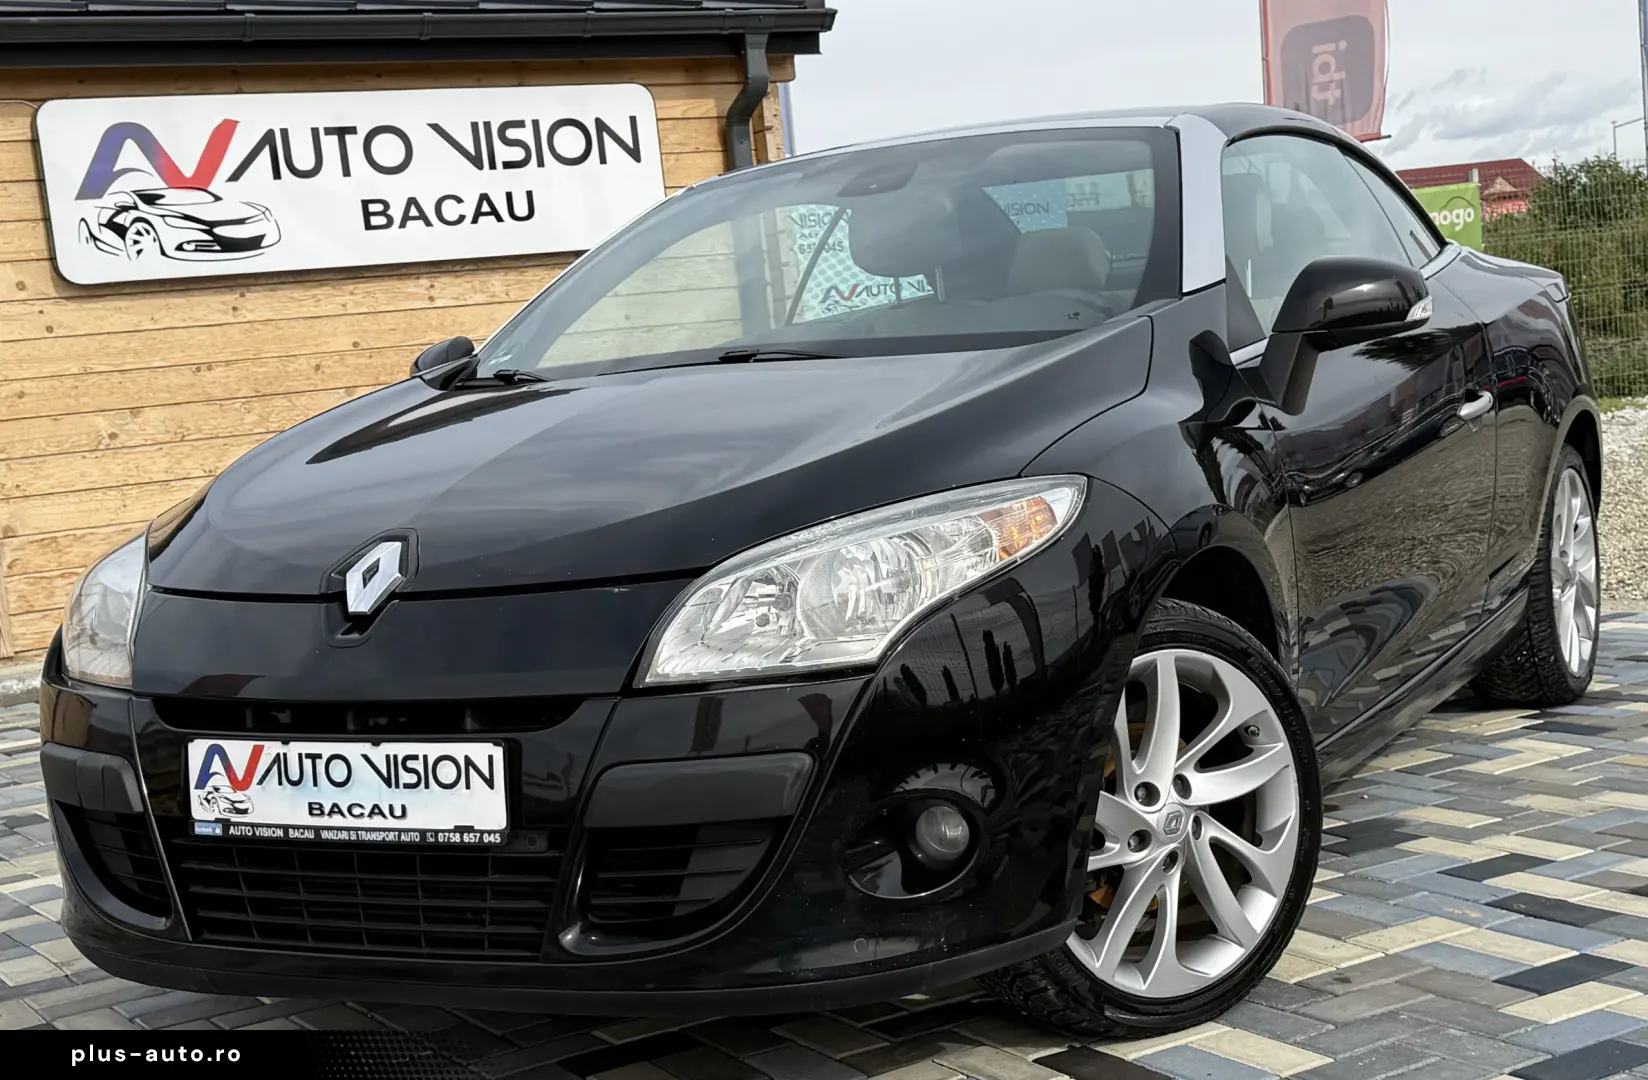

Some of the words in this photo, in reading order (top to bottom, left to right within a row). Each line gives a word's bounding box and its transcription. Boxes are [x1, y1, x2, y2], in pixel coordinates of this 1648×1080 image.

[225, 124, 414, 183] AUTO
[427, 115, 642, 171] VISION
[361, 190, 537, 231] BACAU
[256, 752, 353, 788] AUTO
[361, 753, 495, 791] VISION
[307, 802, 408, 820] BACAU
[229, 825, 252, 837] AUTO
[254, 826, 284, 838] VISION
[288, 828, 315, 839] BACAU
[320, 829, 349, 840] VANZARI
[350, 830, 357, 841] SI
[357, 830, 399, 842] TRANSPORT
[400, 832, 420, 842] AUTO
[438, 832, 461, 843] 0758
[463, 832, 480, 843] 657
[483, 833, 501, 843] 045
